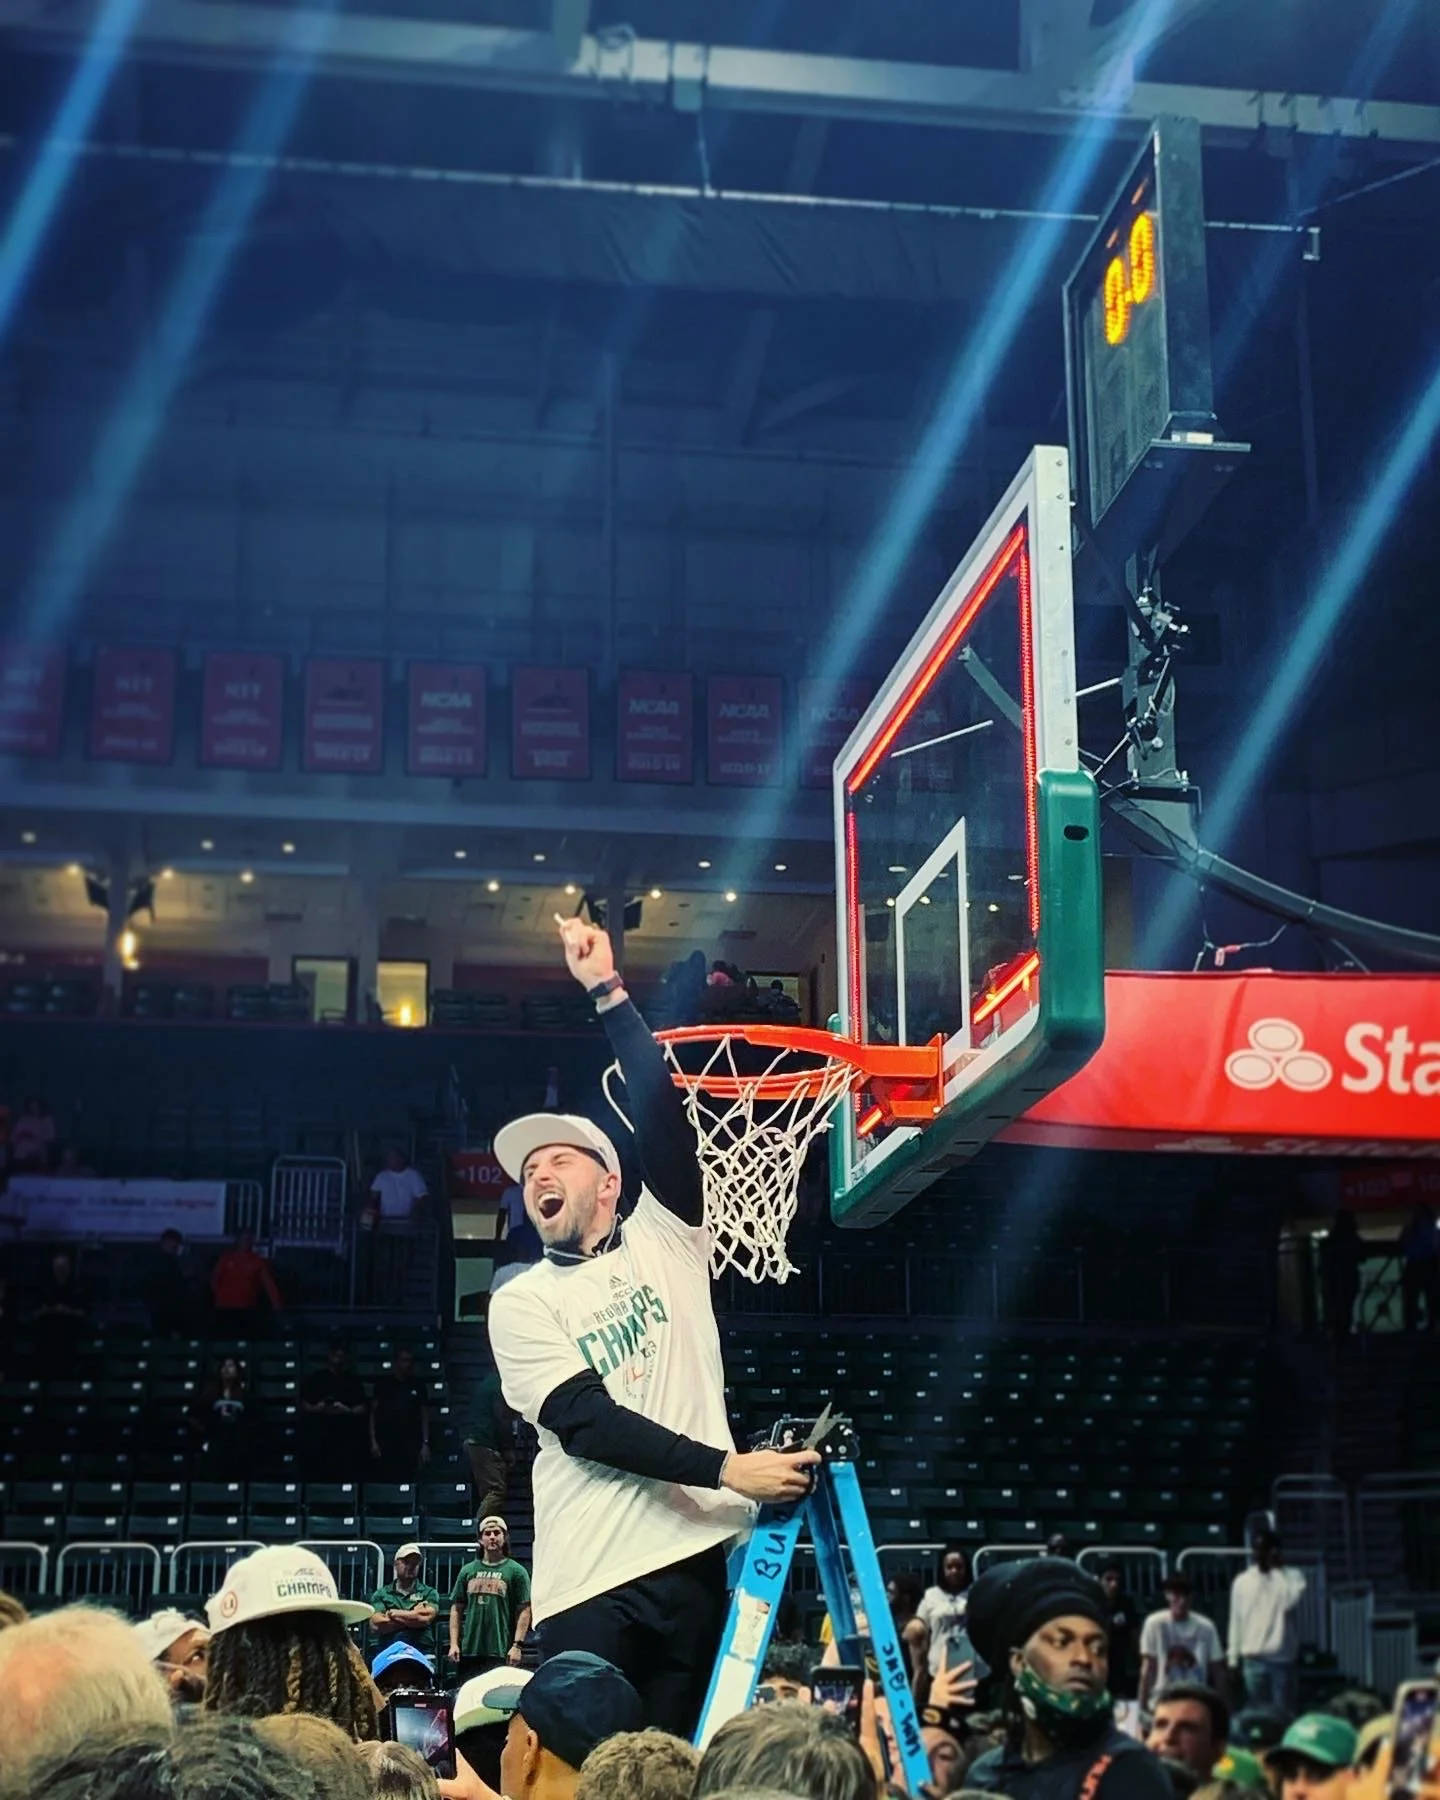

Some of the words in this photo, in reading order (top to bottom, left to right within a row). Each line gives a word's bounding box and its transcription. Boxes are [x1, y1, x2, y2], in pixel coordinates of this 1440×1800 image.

[1341, 1022, 1440, 1096] Sta
[468, 1165, 503, 1184] 102
[277, 1580, 333, 1599] CHAMPS
